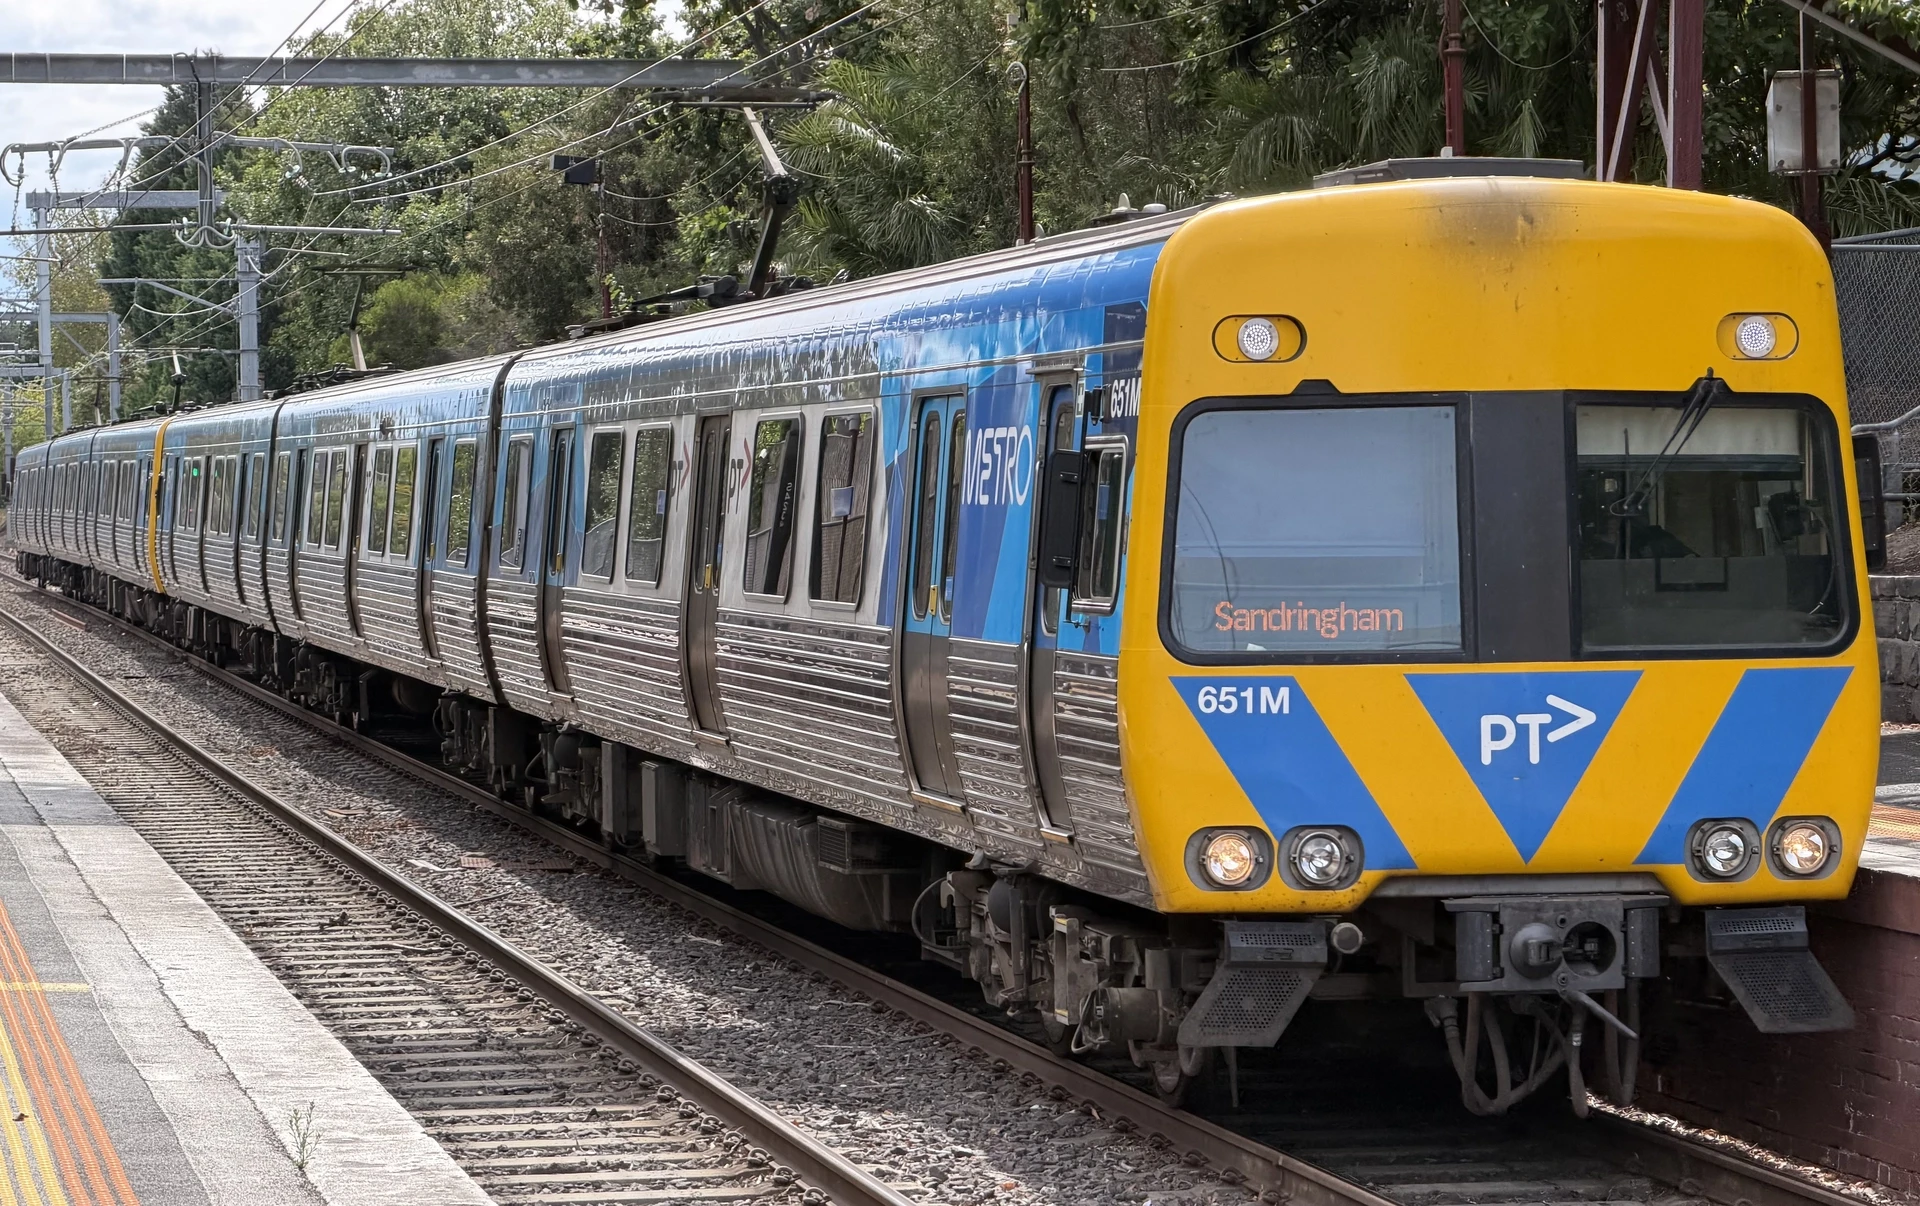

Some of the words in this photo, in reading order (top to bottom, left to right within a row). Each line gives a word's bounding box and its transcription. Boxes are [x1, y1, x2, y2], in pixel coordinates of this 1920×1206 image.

[1110, 377, 1142, 418] 651M
[962, 424, 1033, 506] METRO
[1215, 601, 1403, 639] Sandringham
[1197, 686, 1290, 714] 651M
